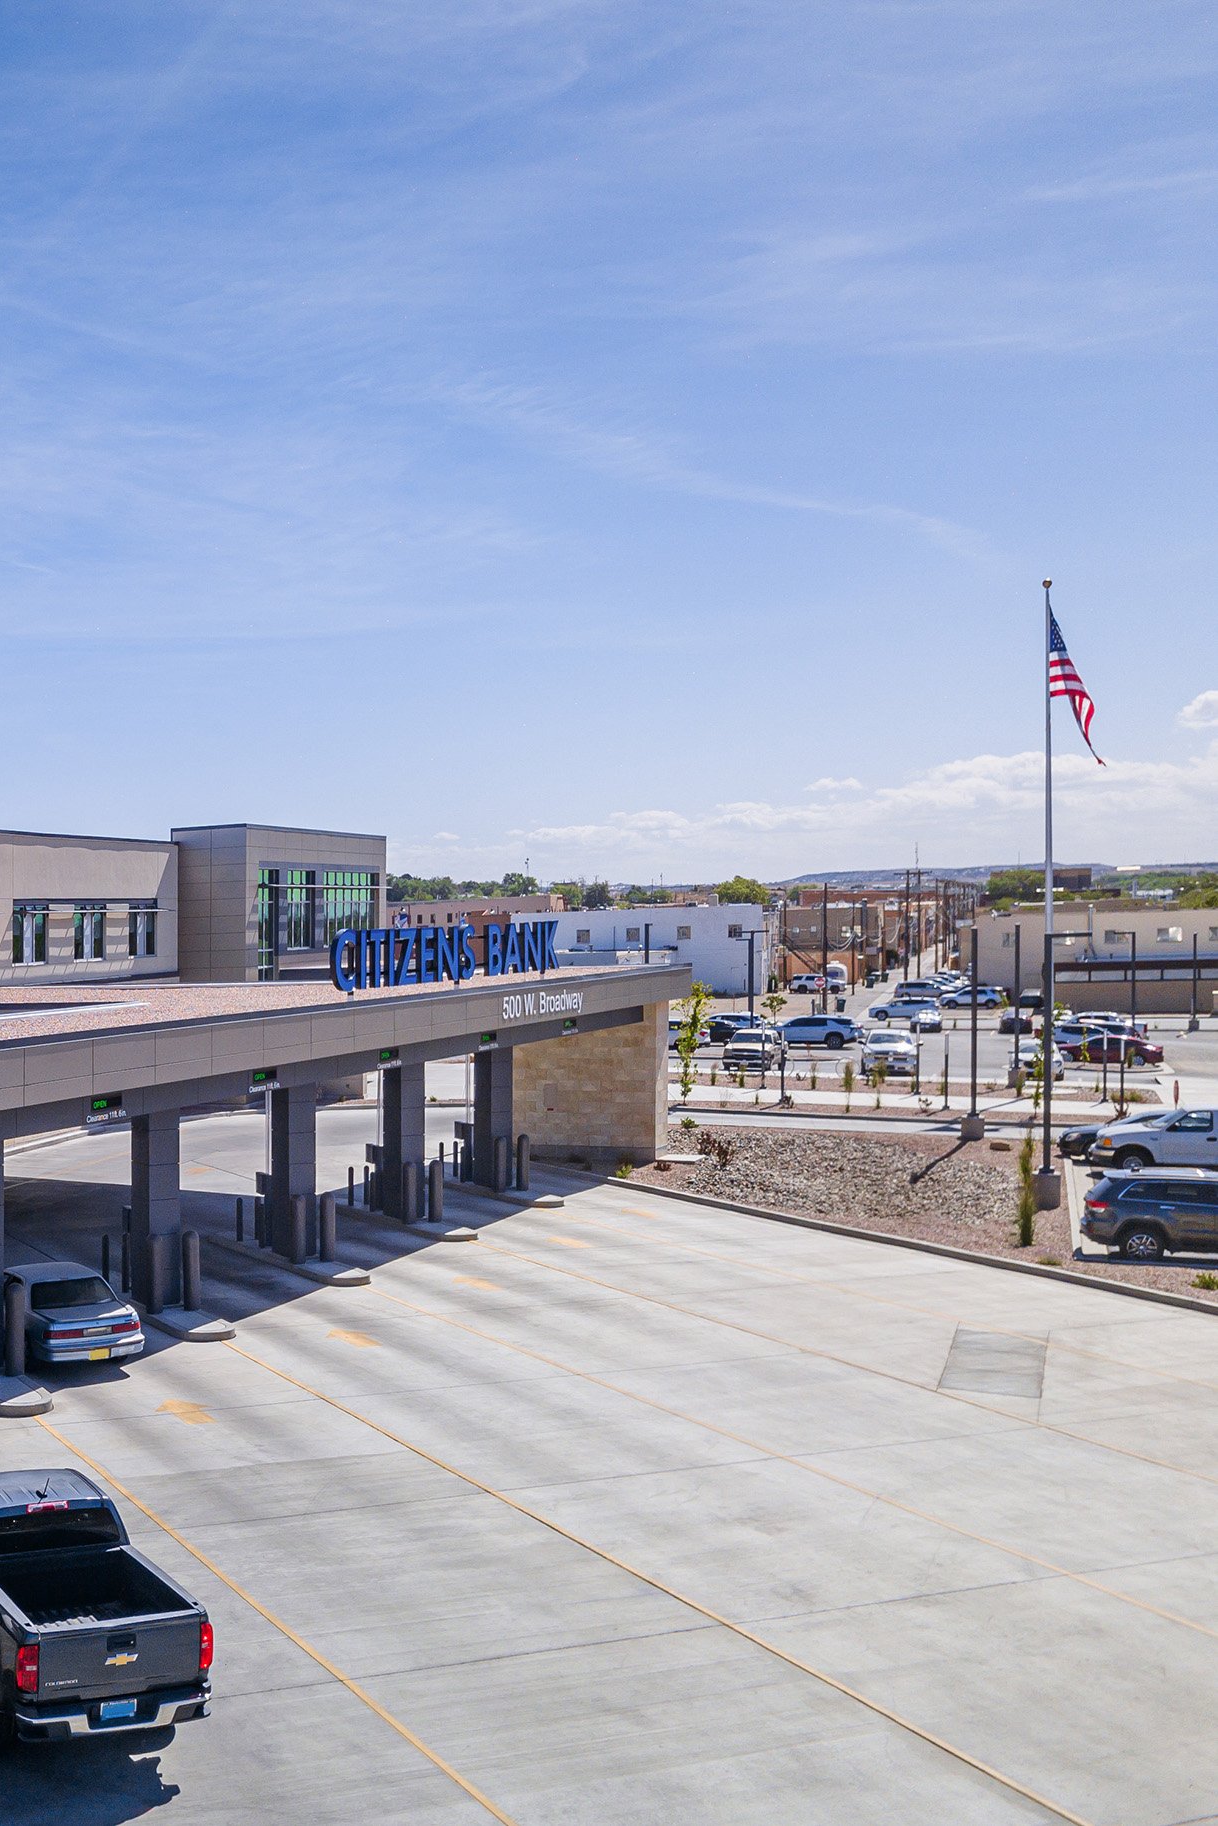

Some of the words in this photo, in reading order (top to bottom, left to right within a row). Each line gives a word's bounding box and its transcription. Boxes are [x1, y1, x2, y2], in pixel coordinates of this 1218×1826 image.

[329, 923, 475, 992] CITIZENS
[485, 920, 558, 976] BANK
[502, 995, 522, 1020] 500
[524, 993, 536, 1016] W.
[539, 989, 584, 1014] Broadway
